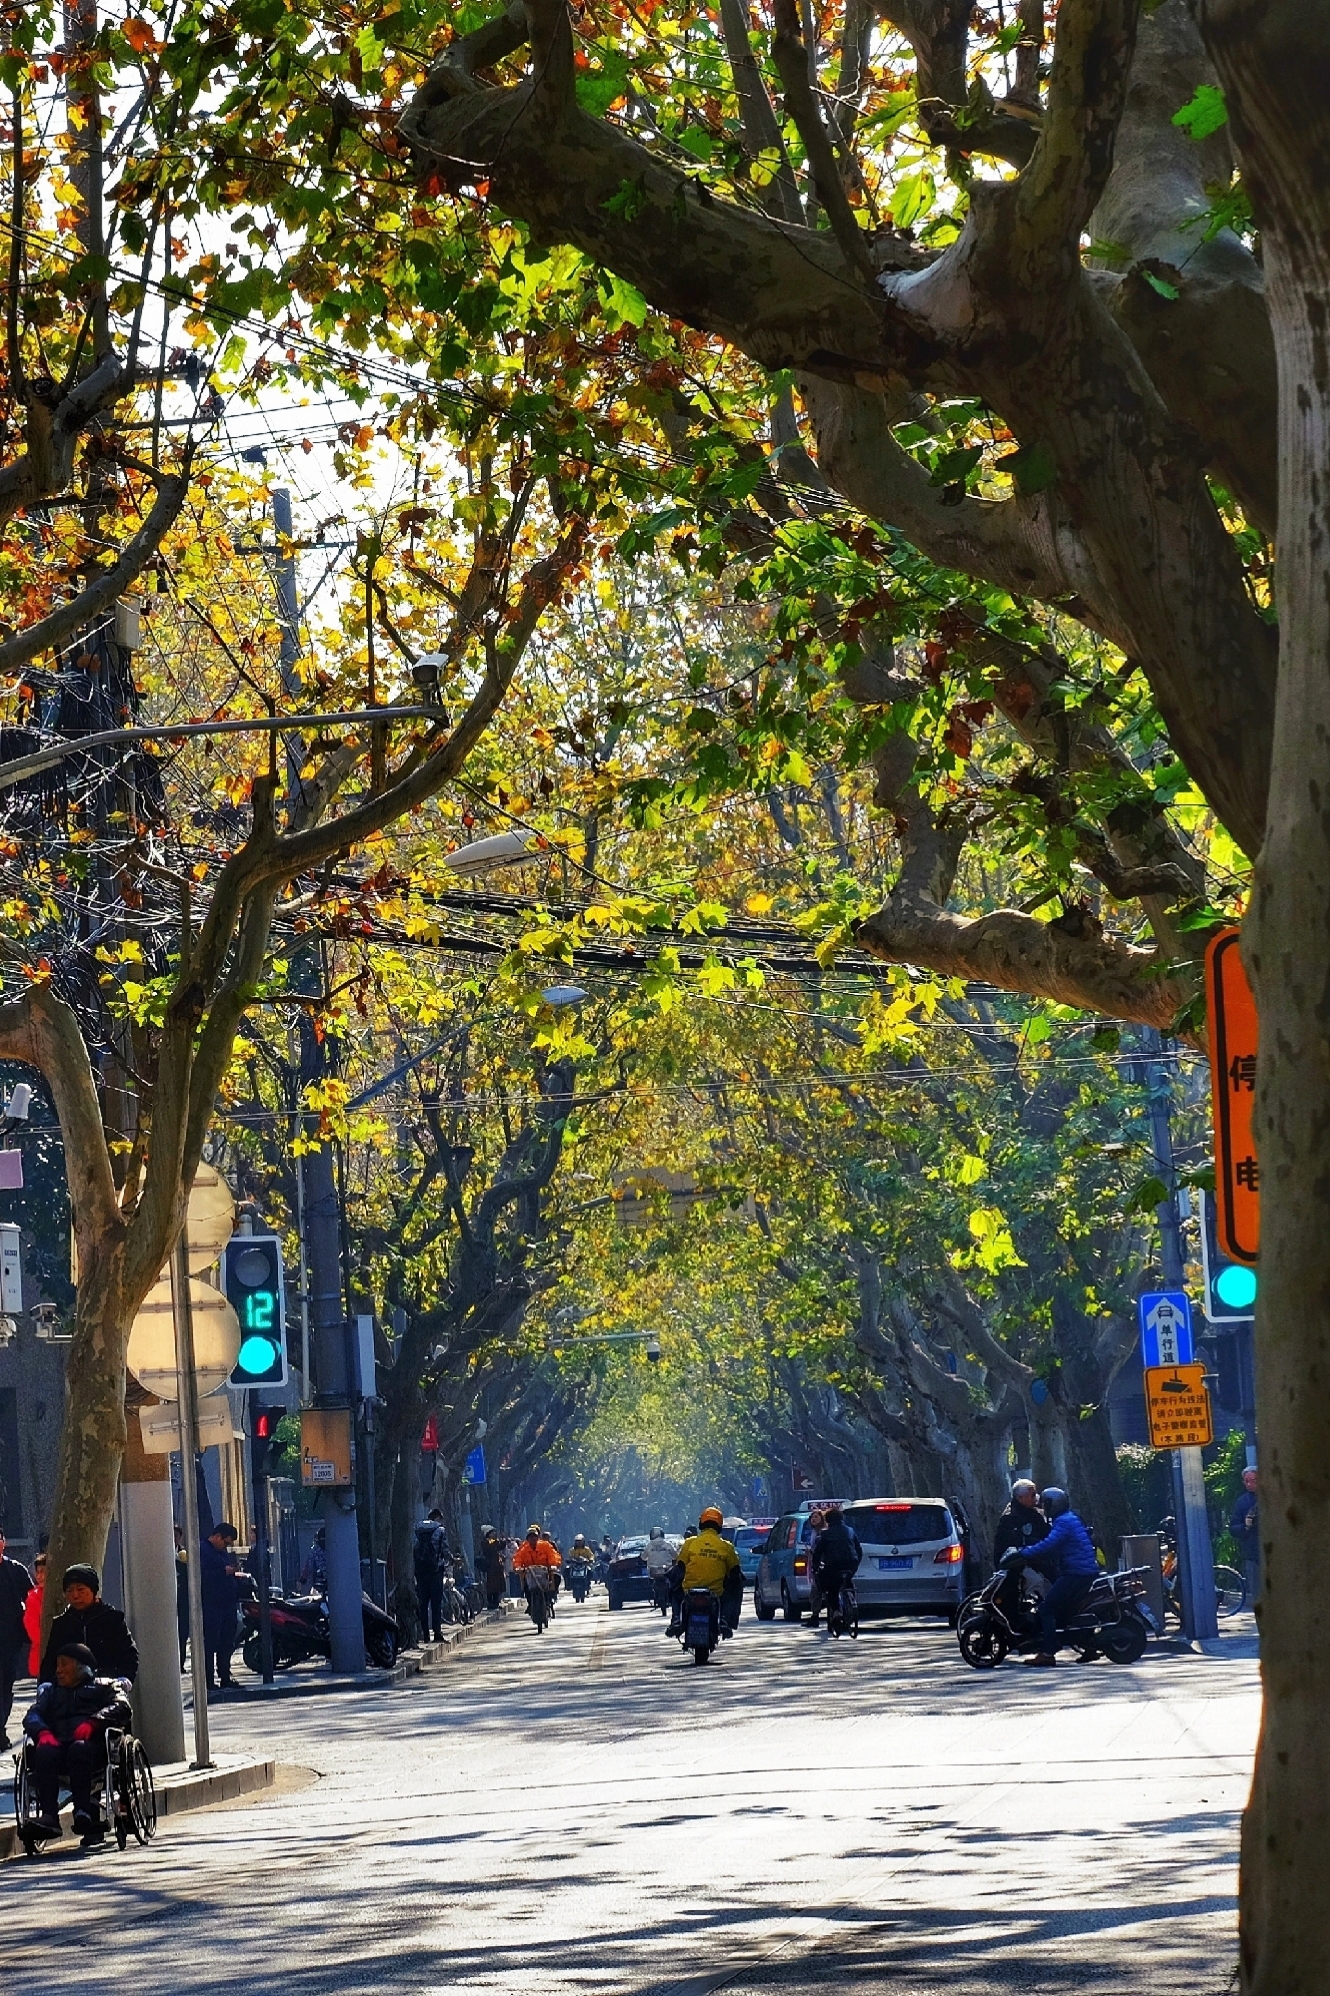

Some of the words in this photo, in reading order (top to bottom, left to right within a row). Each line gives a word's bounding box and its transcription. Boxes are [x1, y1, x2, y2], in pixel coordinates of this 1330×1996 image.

[247, 1292, 273, 1328] 12
[1161, 1324, 1174, 1362] 单行道
